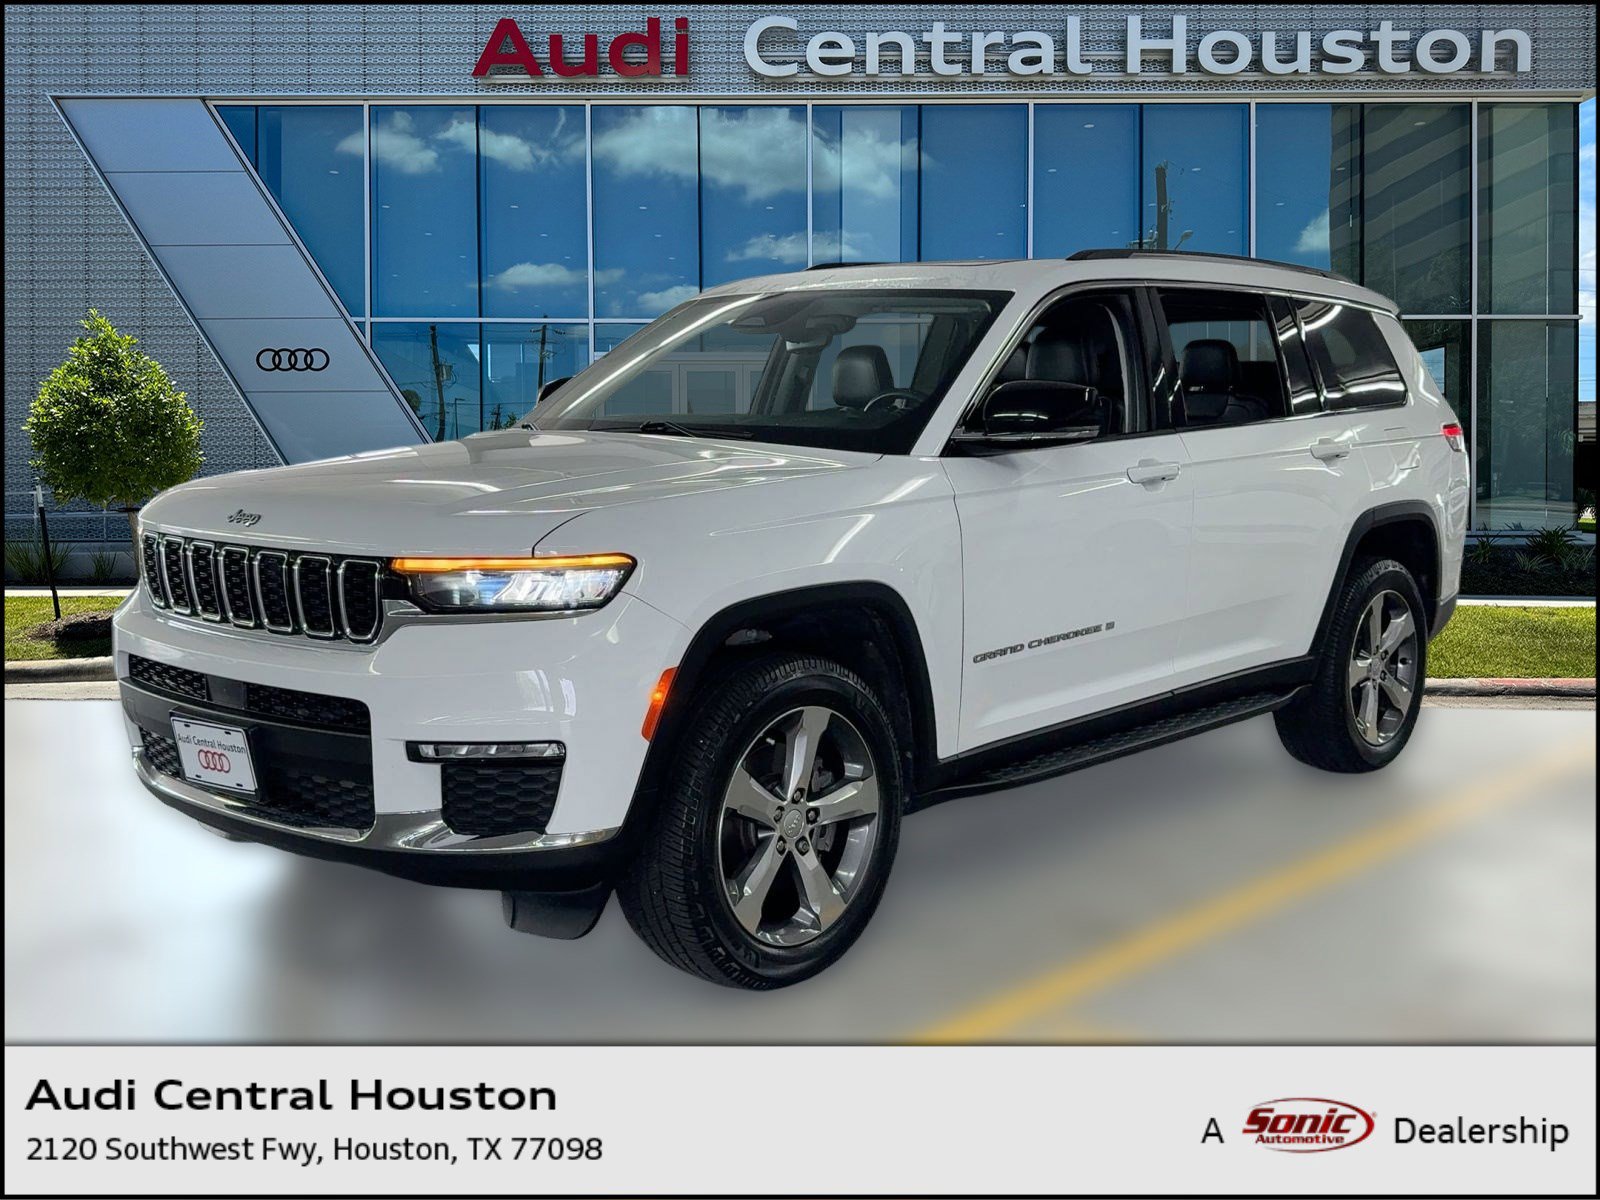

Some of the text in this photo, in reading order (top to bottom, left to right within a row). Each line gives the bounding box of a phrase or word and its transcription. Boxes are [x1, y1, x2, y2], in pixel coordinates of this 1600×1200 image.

[472, 15, 1532, 78] Audi Central Houston
[228, 509, 262, 527] Jeep
[973, 643, 1025, 663] GRAND
[1027, 624, 1102, 649] CHEROKEE
[177, 732, 247, 754] Audi Central Houston
